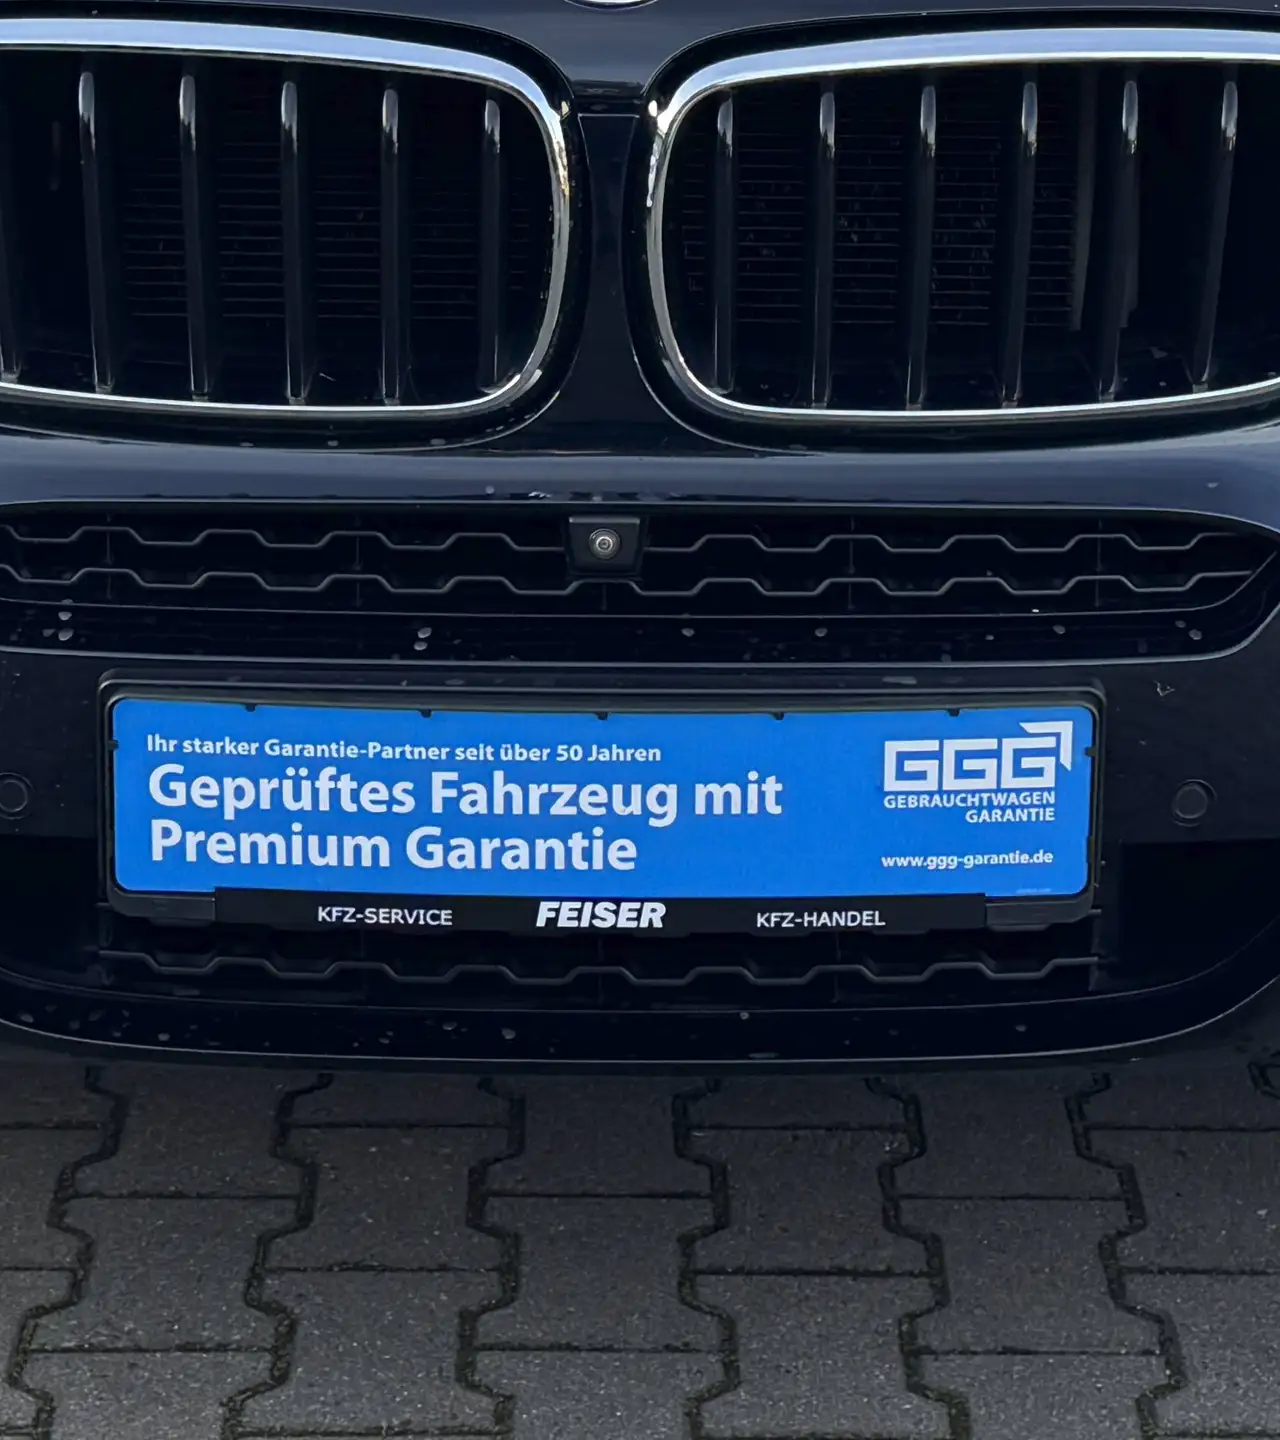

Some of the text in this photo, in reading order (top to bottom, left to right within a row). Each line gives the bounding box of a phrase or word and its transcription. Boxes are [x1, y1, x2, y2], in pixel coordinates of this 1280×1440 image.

[147, 734, 661, 762] Ihr starker Garantie-Partner seit über 50 Jahren
[884, 736, 1057, 791] GGG
[149, 763, 783, 827] Geprüftes Fahrzeug mit
[884, 791, 1056, 809] GEBRAUCHTWAGEN
[965, 808, 1056, 824] GARANTIE
[151, 819, 637, 871] Premium Garantie
[881, 849, 1054, 870] www.ggg-garantie.de
[318, 901, 886, 929] KFZ-SERVICE FEISER KFZ-HANDEL
